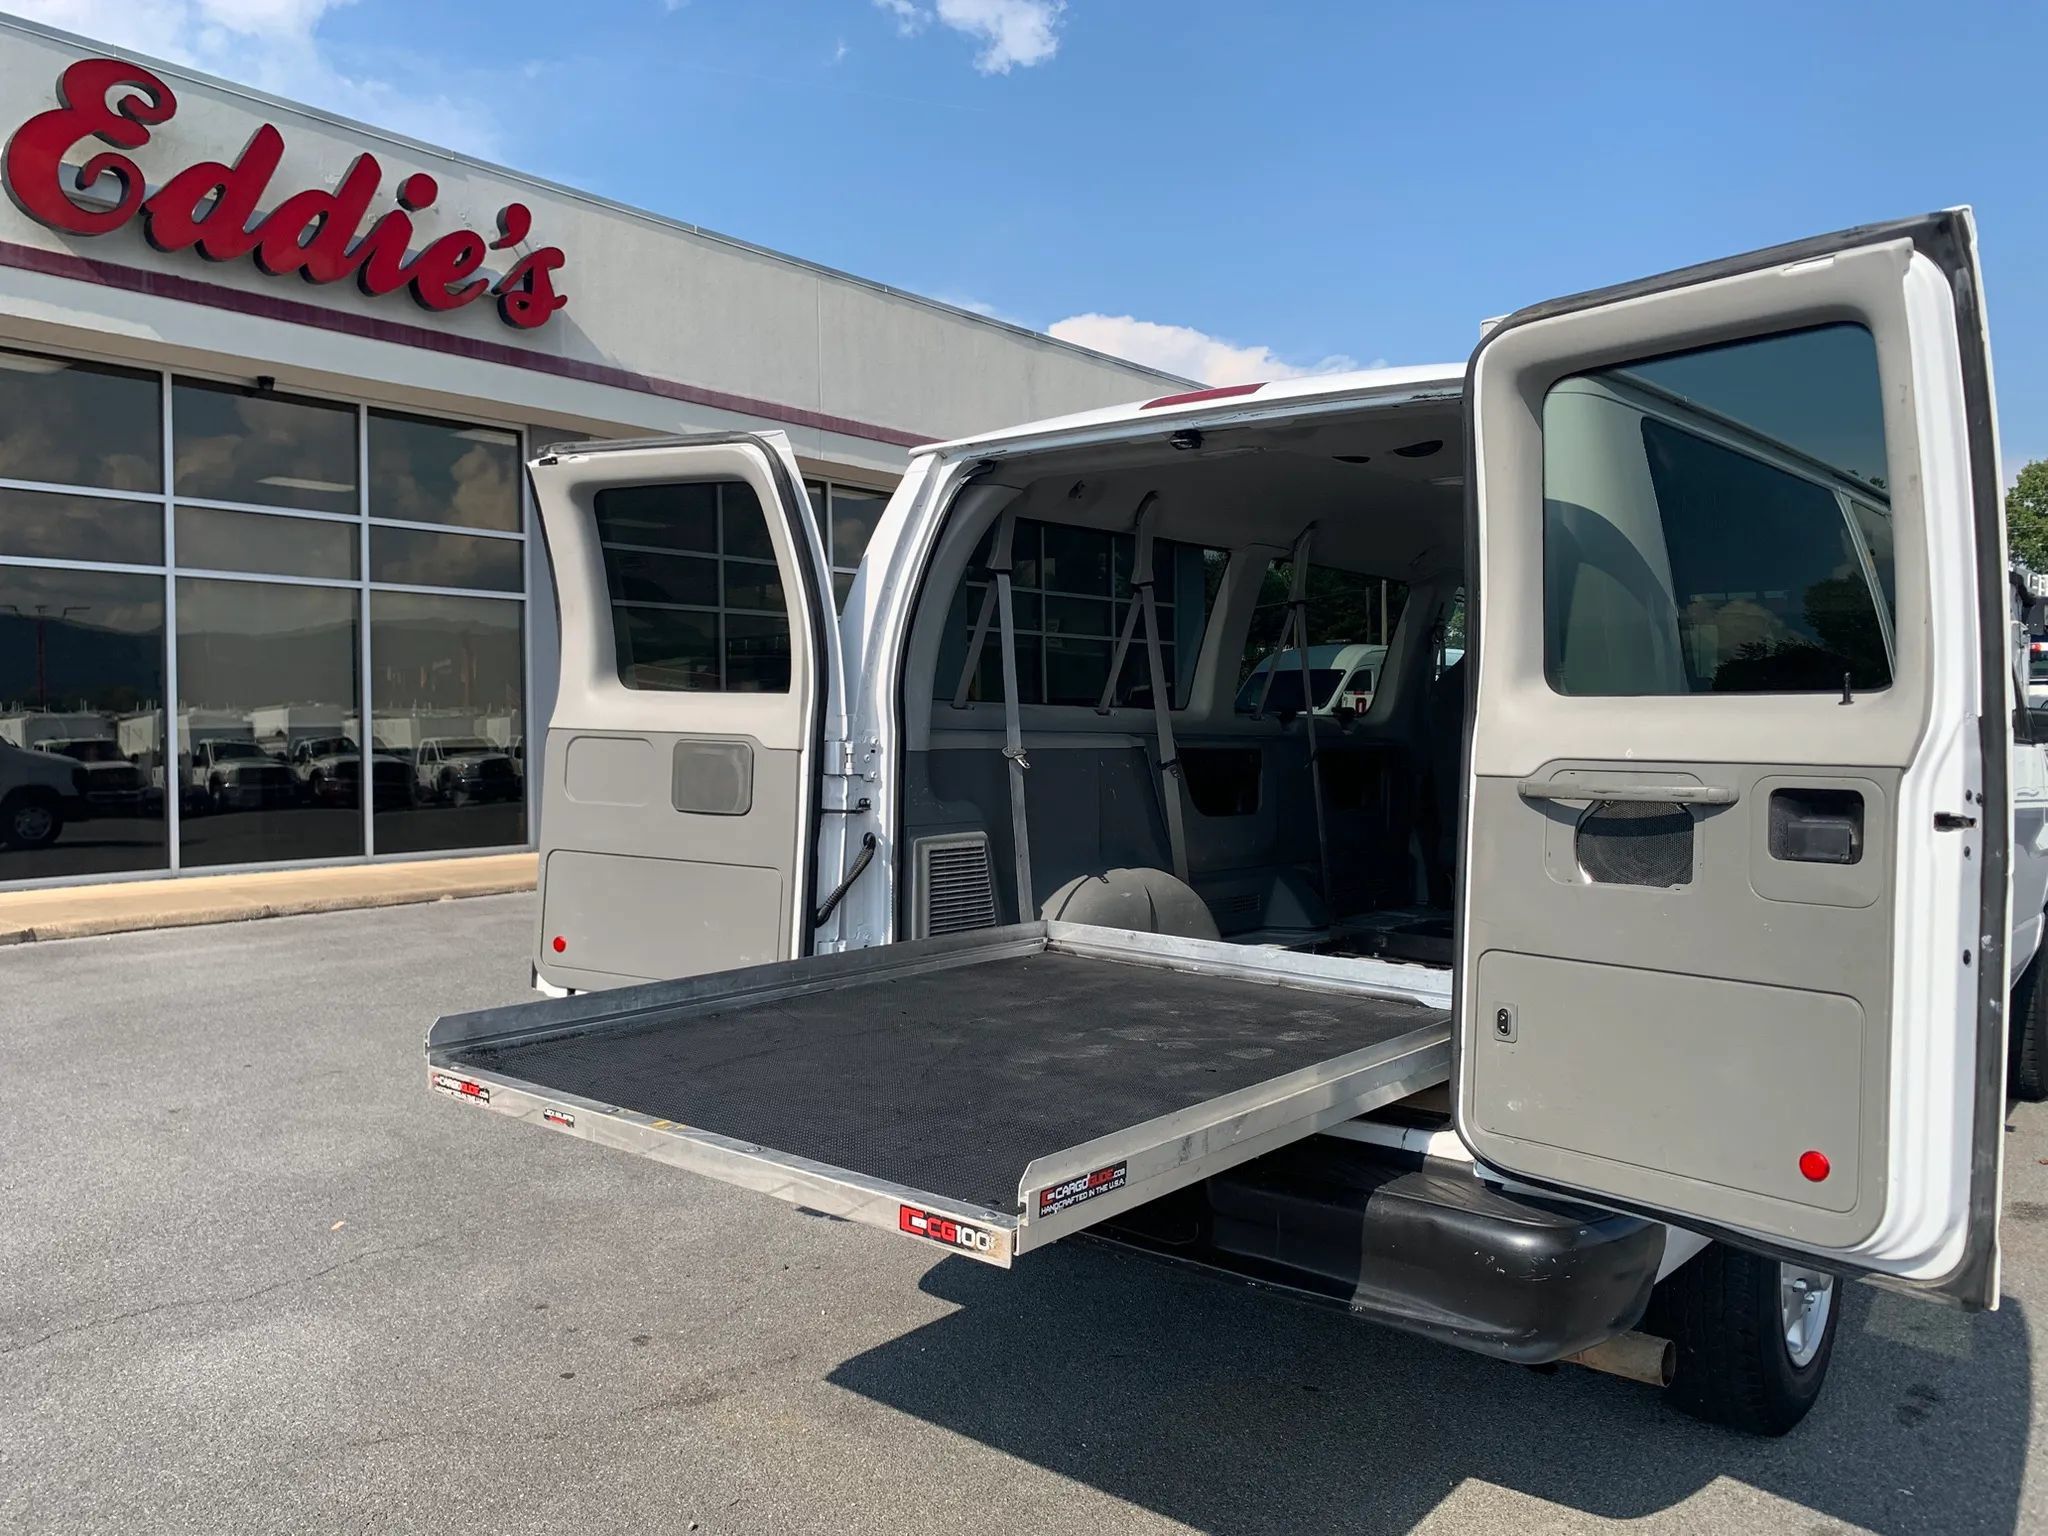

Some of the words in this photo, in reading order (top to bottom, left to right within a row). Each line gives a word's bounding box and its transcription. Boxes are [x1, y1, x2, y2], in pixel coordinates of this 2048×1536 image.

[3, 58, 567, 329] Eddie's
[1041, 1192, 1088, 1215] HANDCRAFTED
[1089, 1188, 1095, 1197] IN
[1096, 1183, 1109, 1193] THE
